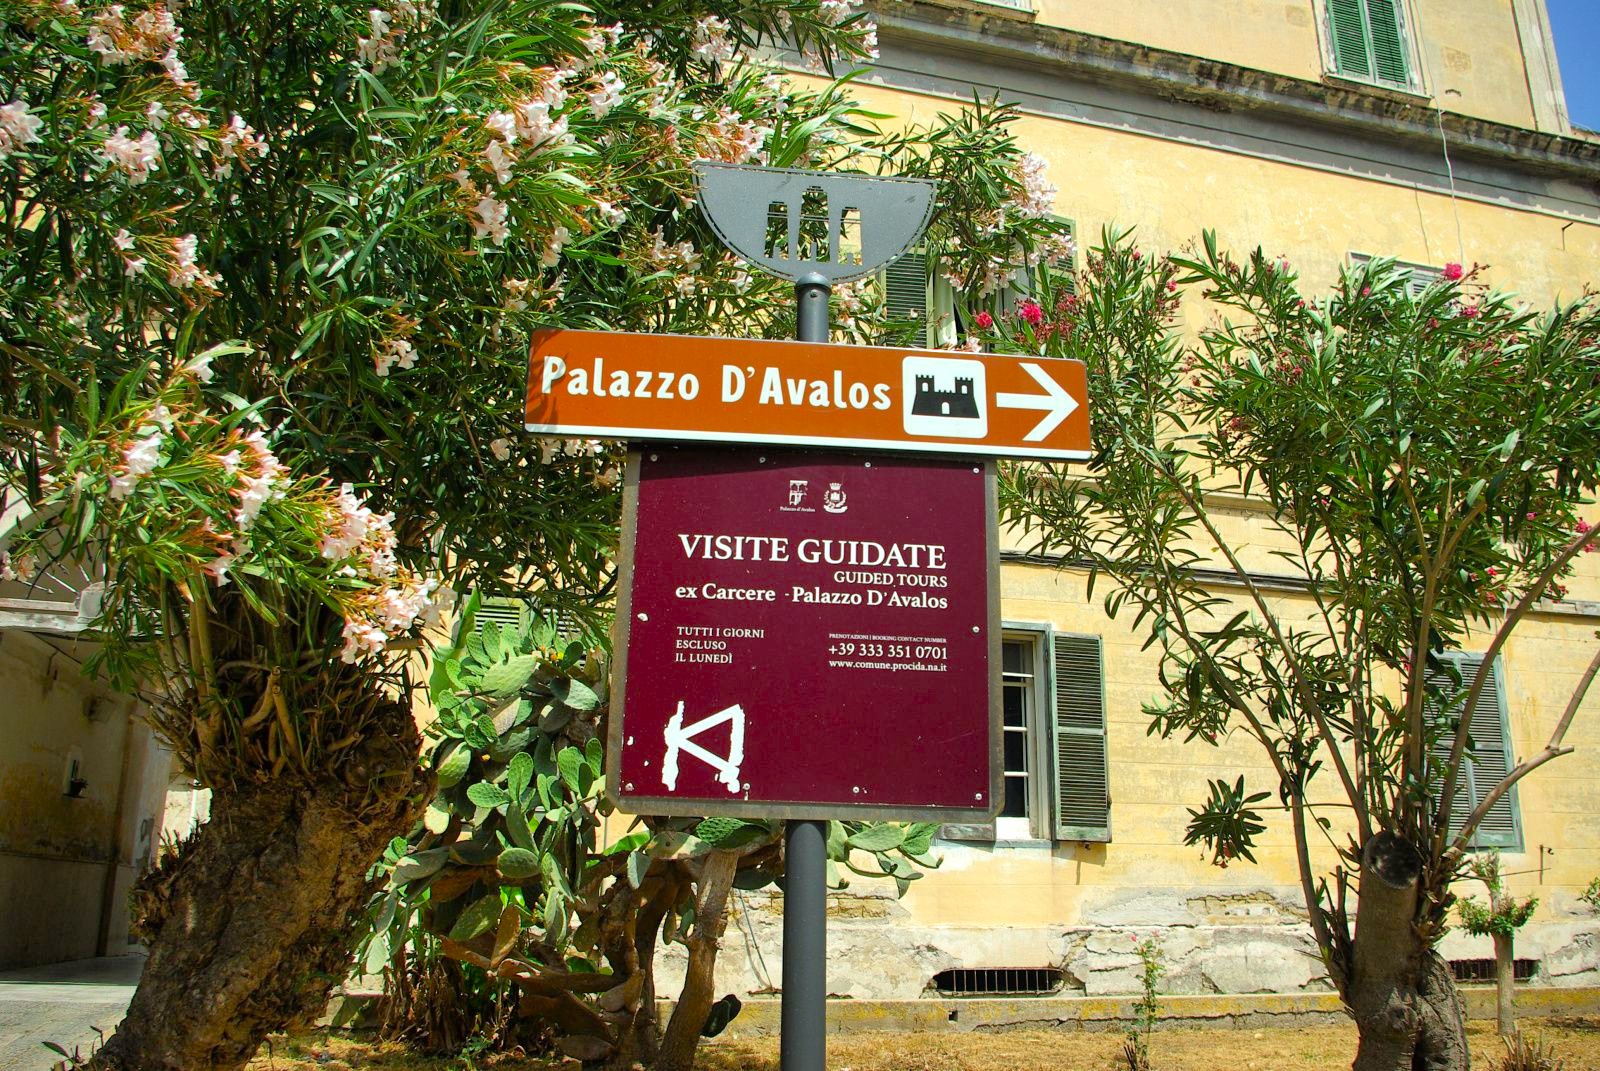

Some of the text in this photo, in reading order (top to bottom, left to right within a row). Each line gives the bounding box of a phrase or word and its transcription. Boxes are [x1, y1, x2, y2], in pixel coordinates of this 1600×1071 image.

[541, 355, 892, 411] Palazzo D'Avalos
[678, 533, 947, 569] VISITE GUIDATE
[834, 570, 947, 588] GUIDED TOURS
[675, 586, 697, 599] ex
[701, 583, 776, 601] Carcere
[792, 586, 862, 605] Palazzo
[866, 589, 948, 609] D'Avalos
[677, 626, 765, 638] TUTTI I GIORNI
[676, 640, 727, 650] ESCLUSO
[828, 643, 947, 660] +39 333 351 0701
[675, 652, 732, 664] IL LUNEDÌ
[829, 660, 947, 672] www.comune.procida.na.it
